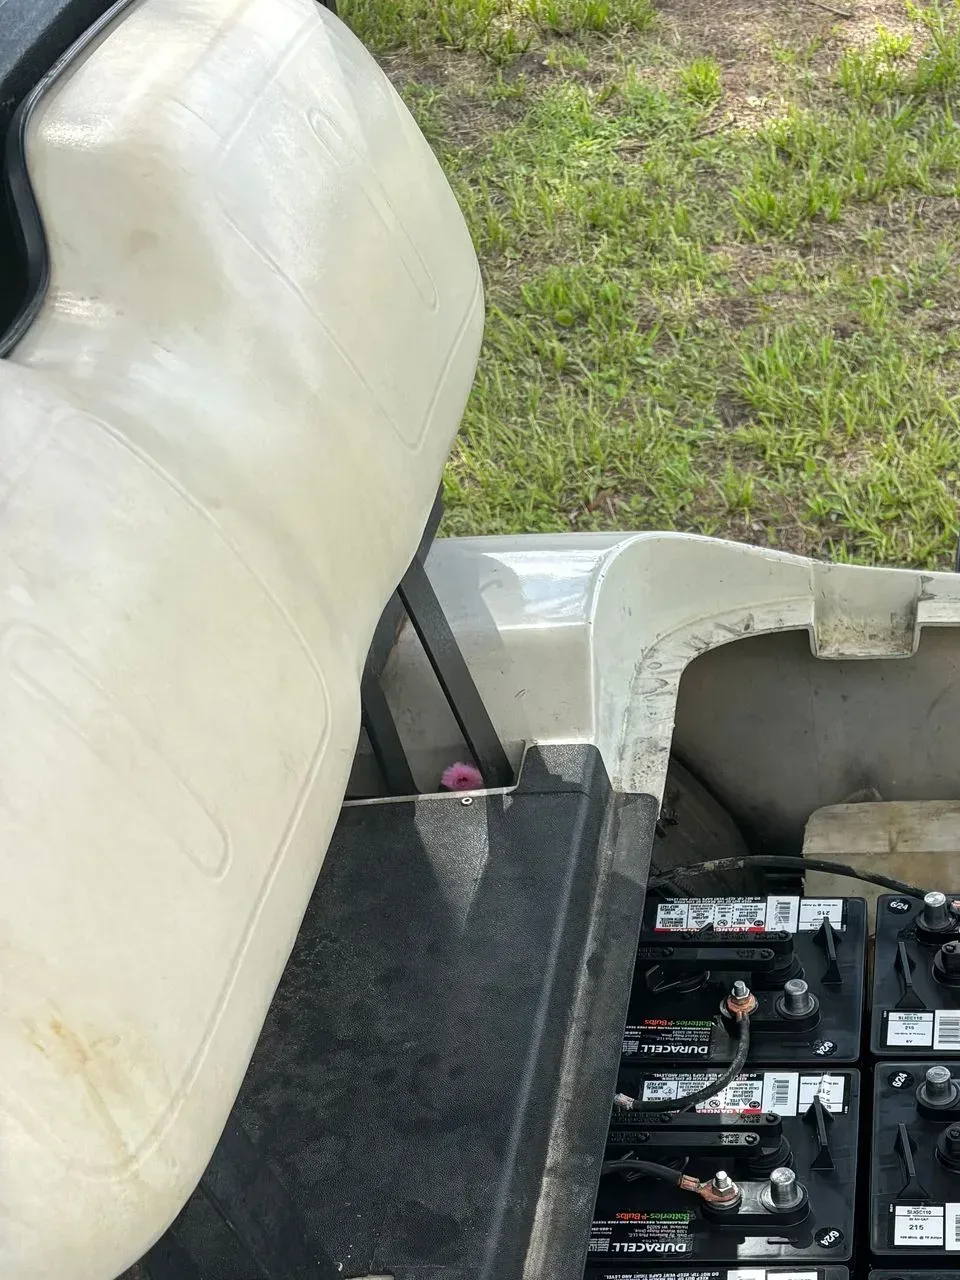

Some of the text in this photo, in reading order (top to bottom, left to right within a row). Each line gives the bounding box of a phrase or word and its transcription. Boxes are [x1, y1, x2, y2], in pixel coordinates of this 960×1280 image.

[890, 901, 909, 911] 6/24
[641, 1045, 708, 1054] DURACELL
[816, 1041, 833, 1055] 6/24
[892, 1072, 908, 1088] 6/24
[820, 1230, 839, 1246] 6/24
[612, 1242, 687, 1252] DURACELL
